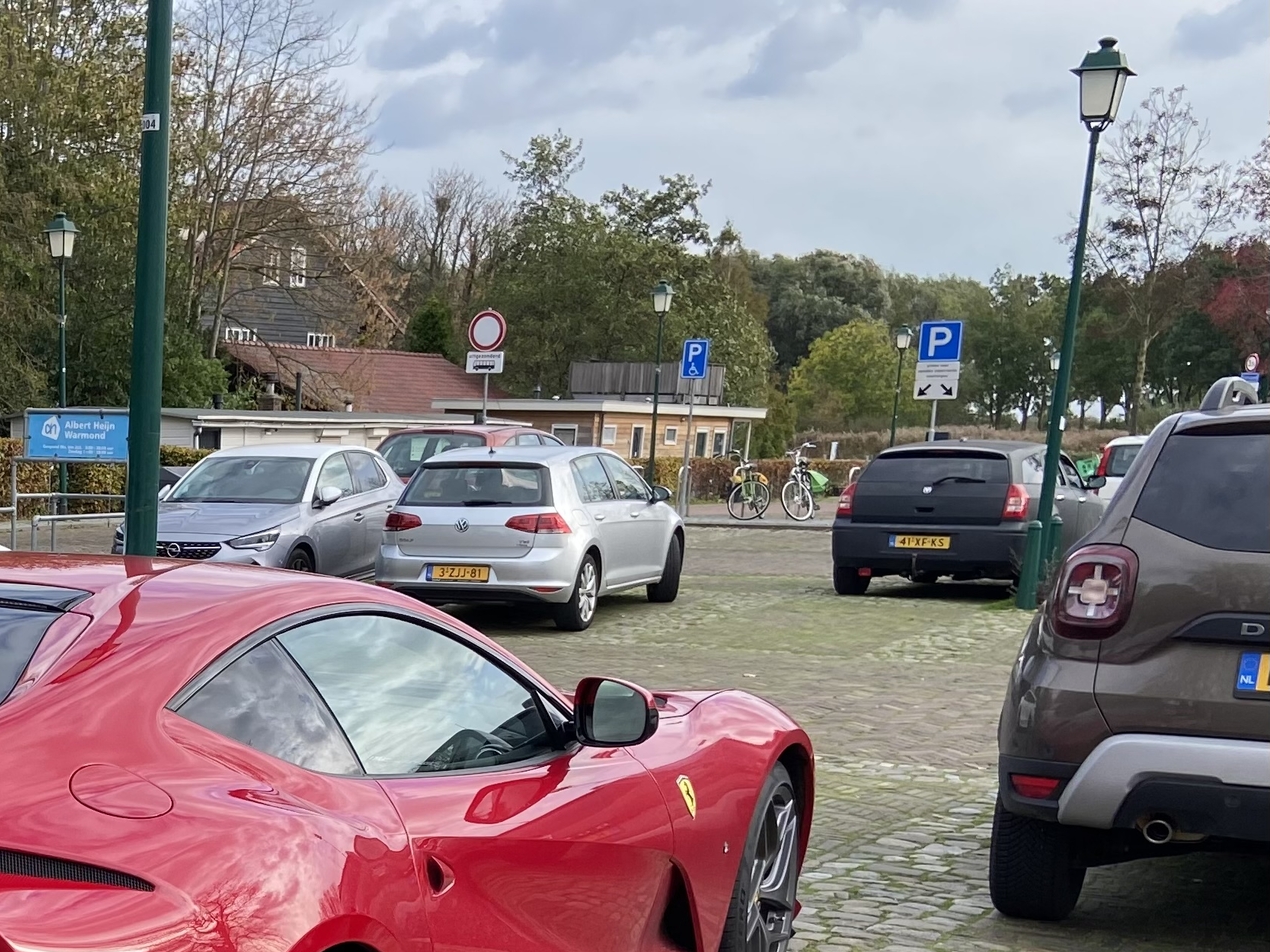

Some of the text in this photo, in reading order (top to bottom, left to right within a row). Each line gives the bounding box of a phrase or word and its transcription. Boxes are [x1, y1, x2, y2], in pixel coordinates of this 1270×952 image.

[928, 327, 953, 357] P
[688, 343, 703, 362] P
[64, 421, 116, 432] Albert Heijn
[64, 431, 106, 440] Warmond
[1240, 622, 1266, 636] D
[1239, 674, 1255, 685] NL
